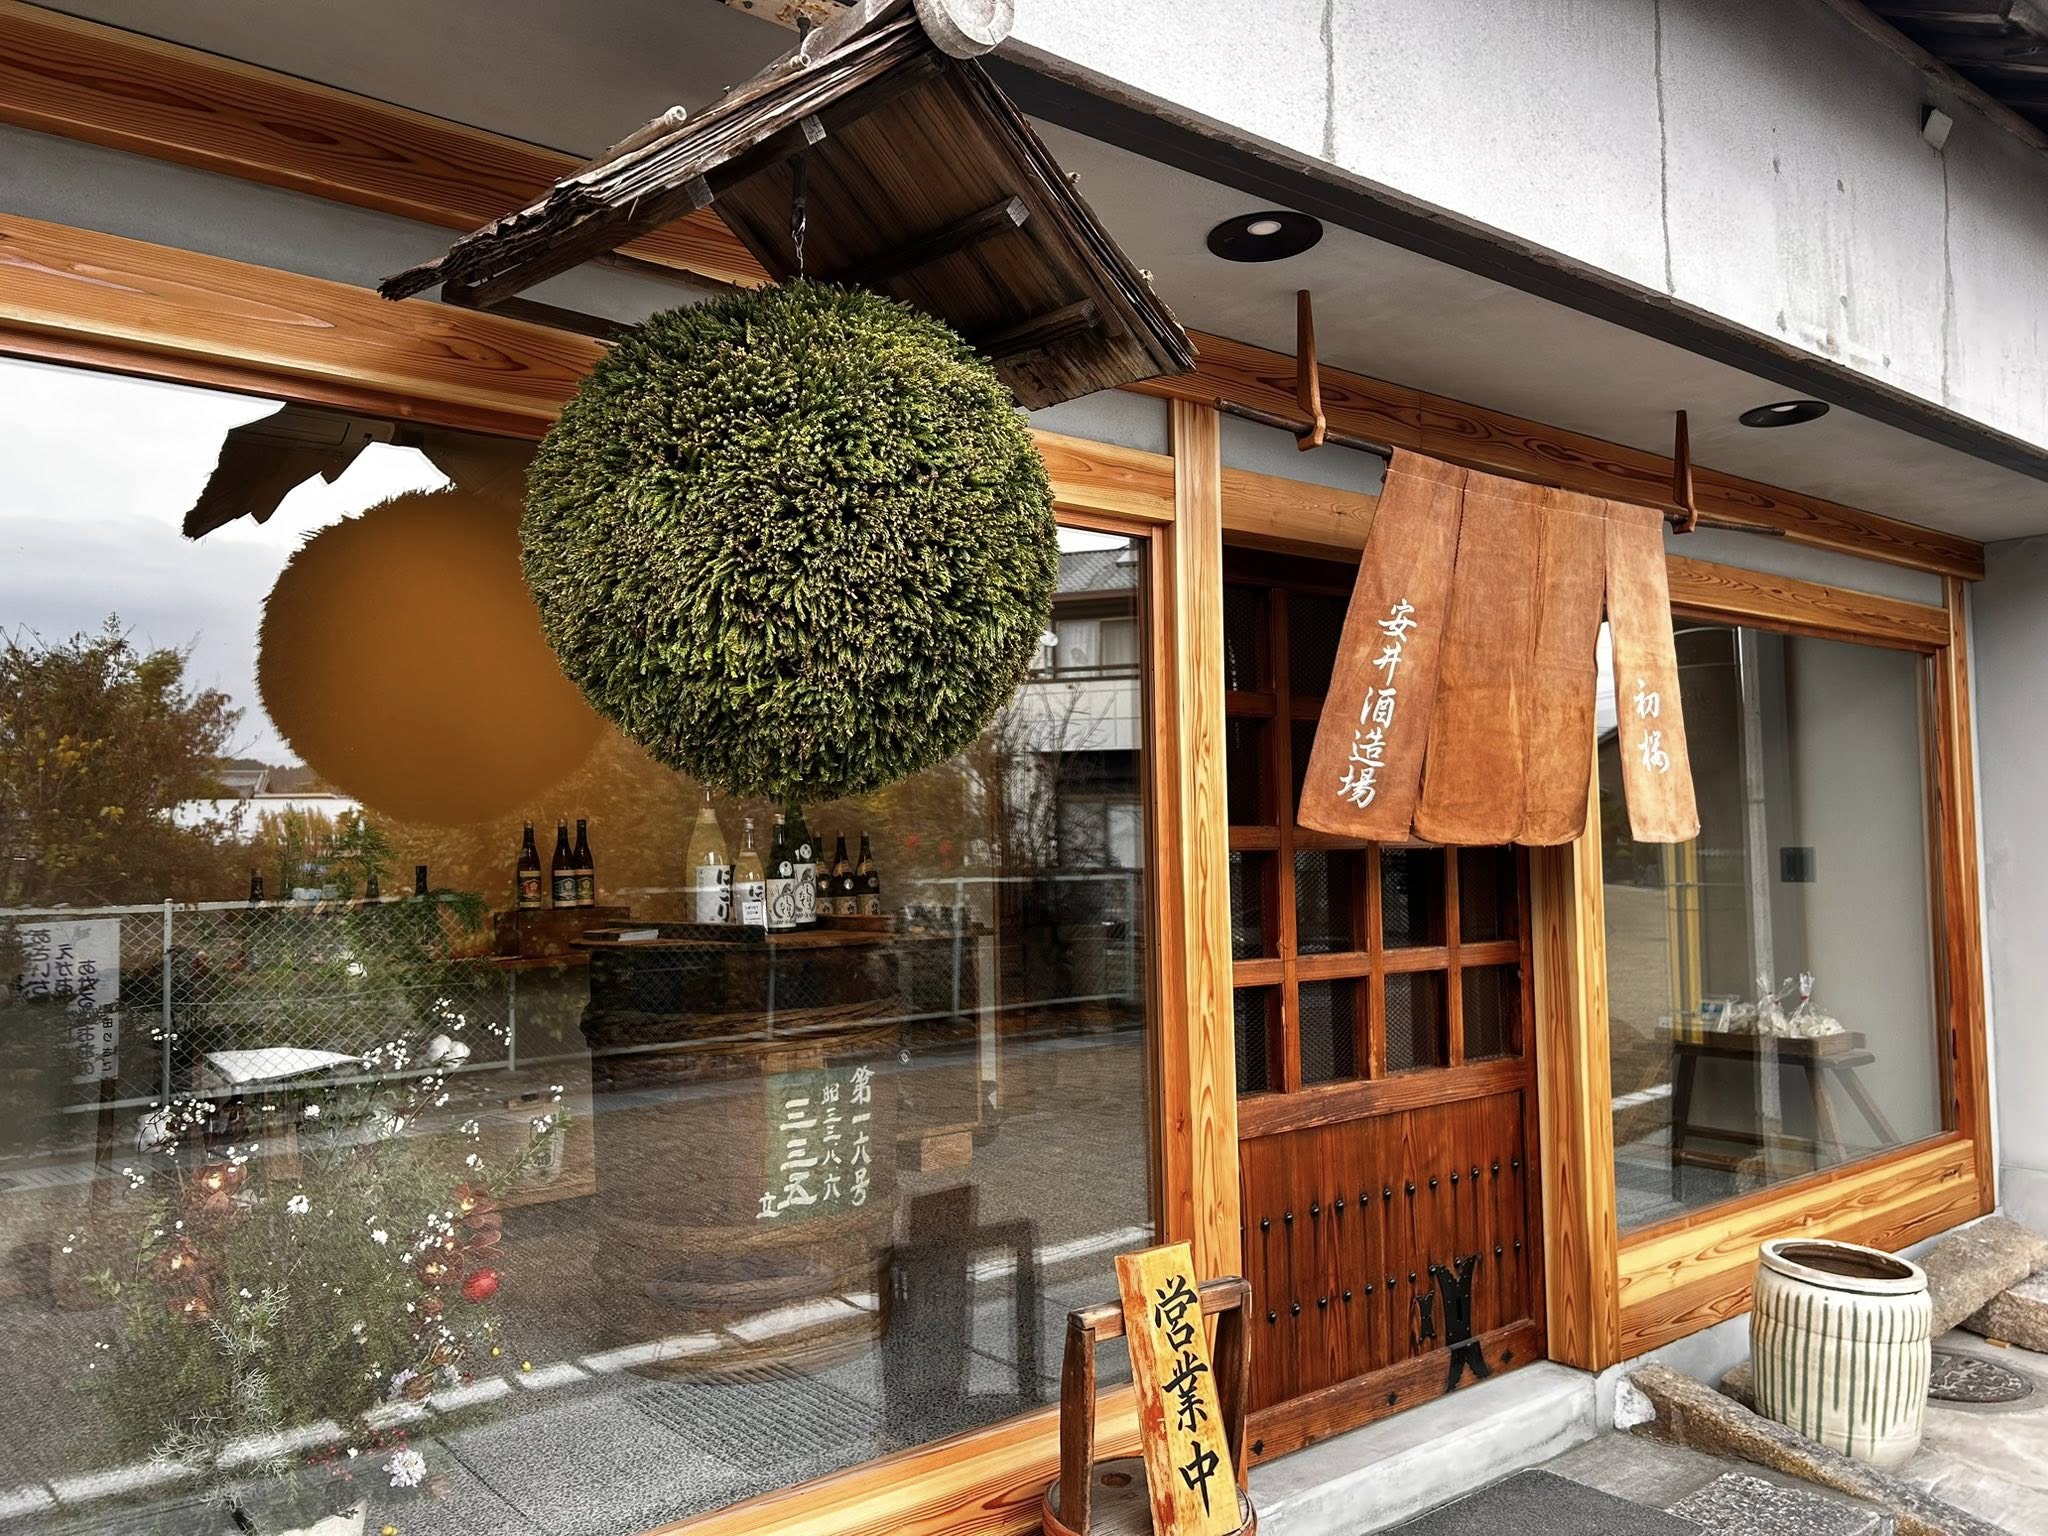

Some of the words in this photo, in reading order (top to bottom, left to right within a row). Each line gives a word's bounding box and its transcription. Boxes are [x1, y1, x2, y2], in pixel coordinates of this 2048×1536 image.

[1337, 598, 1417, 809] 安井酒造場
[850, 1065, 875, 1206] 第一六号
[1154, 1275, 1220, 1518] 営業中
